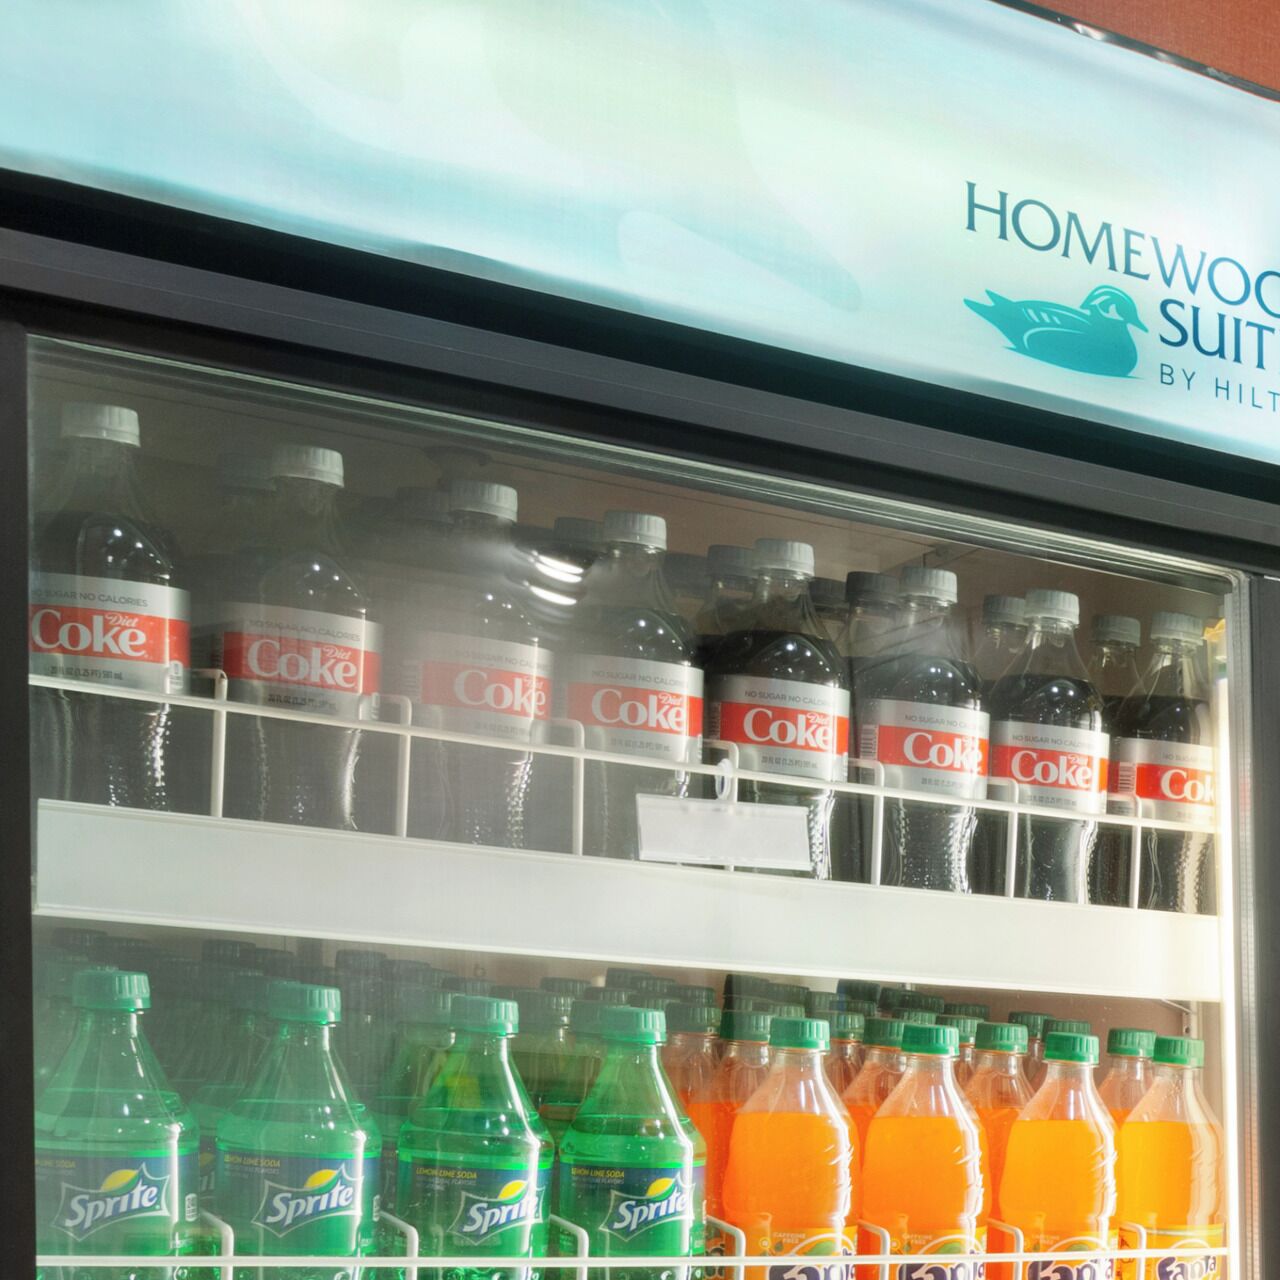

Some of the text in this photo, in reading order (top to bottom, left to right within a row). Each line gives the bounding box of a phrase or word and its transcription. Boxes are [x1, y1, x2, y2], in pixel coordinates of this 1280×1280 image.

[1159, 363, 1196, 391] BY
[79, 592, 97, 601] NO
[97, 593, 149, 608] CALORIES
[105, 612, 141, 628] Diet
[31, 608, 148, 657] Coke
[247, 639, 358, 688] Coke
[453, 669, 547, 716] Coke
[591, 688, 688, 732] Coke
[758, 690, 787, 702] SUGAR
[743, 707, 832, 752] Coke
[919, 714, 946, 726] SUGAR
[903, 732, 983, 774] Coke
[1011, 750, 1093, 789] Coke
[1160, 768, 1216, 802] Cok
[456, 1170, 477, 1180] SODA
[64, 1182, 159, 1230] Sprite
[266, 1183, 353, 1230] Sprite
[463, 1192, 539, 1235] Sprite
[612, 1188, 688, 1231] Sprite
